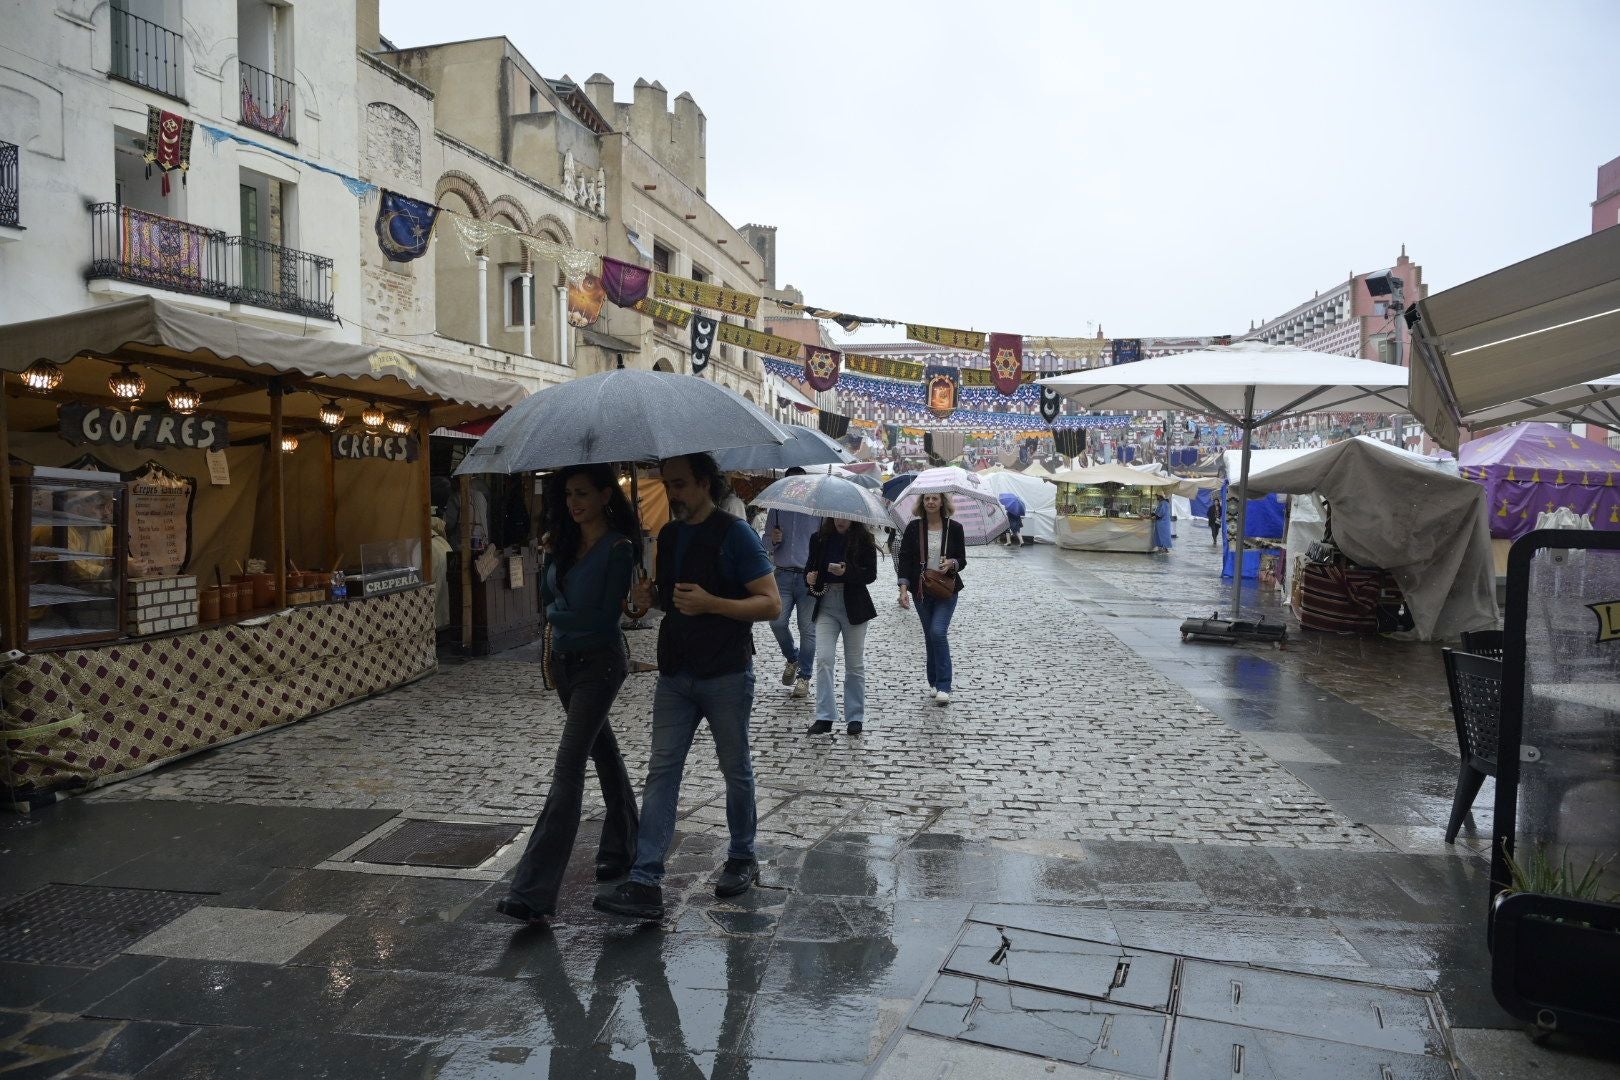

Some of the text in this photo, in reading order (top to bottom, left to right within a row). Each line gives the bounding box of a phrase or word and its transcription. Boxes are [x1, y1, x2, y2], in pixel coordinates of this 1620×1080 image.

[83, 408, 216, 448] GOFRES
[338, 435, 408, 461] CREPES
[366, 573, 420, 593] CREPERÍA
